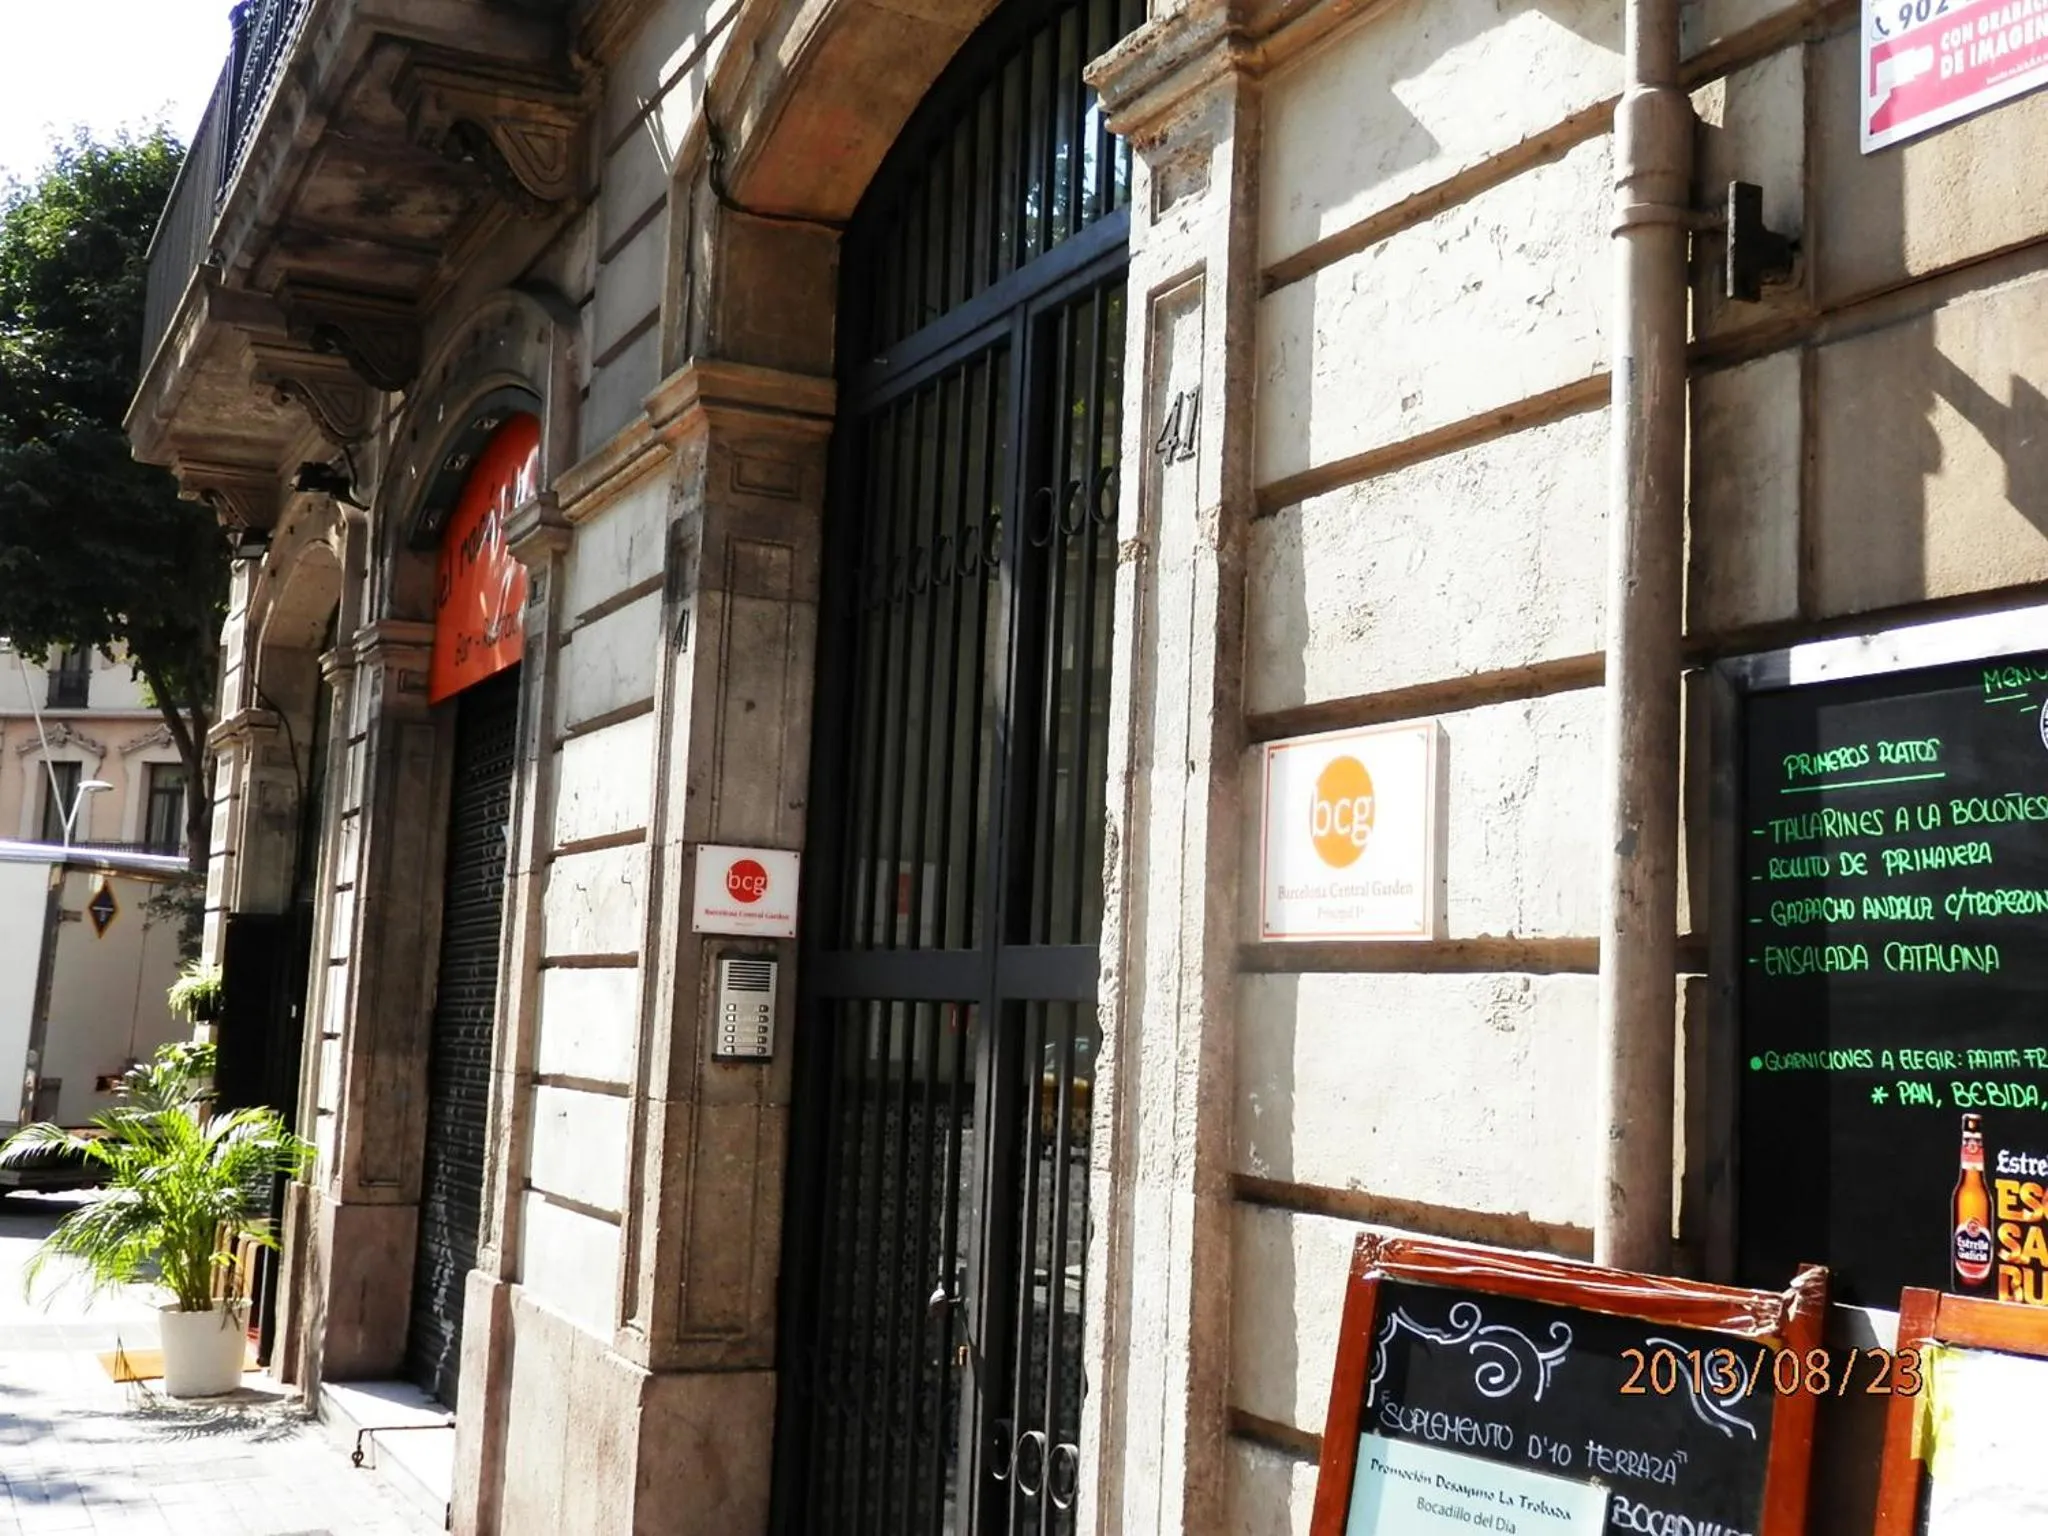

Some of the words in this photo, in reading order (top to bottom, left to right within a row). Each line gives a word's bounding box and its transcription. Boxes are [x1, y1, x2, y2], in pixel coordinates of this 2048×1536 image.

[1940, 21, 1974, 53] CON
[1940, 48, 1965, 81] DE
[1155, 386, 1200, 467] 41
[1783, 744, 1870, 781] PRIMEROS
[1312, 784, 1374, 848] bcg
[1769, 807, 1884, 845] TALLARINES
[1895, 806, 1910, 832] A
[1917, 803, 1942, 832] LA
[1839, 852, 1868, 877] DE
[1882, 842, 1993, 877] PRIMAVERA
[728, 869, 766, 896] bcg
[1372, 879, 1413, 896] Garden
[1771, 896, 1856, 927] GAZPACHO
[1764, 944, 1869, 977] ENSALADA
[1884, 941, 2001, 975] CATALANA
[1765, 1049, 1874, 1072] GUARNICIONES
[1881, 1051, 1895, 1071] A
[1416, 1496, 1472, 1523] Bocadillo
[1473, 1509, 1494, 1530] del
[1498, 1489, 1515, 1507] La
